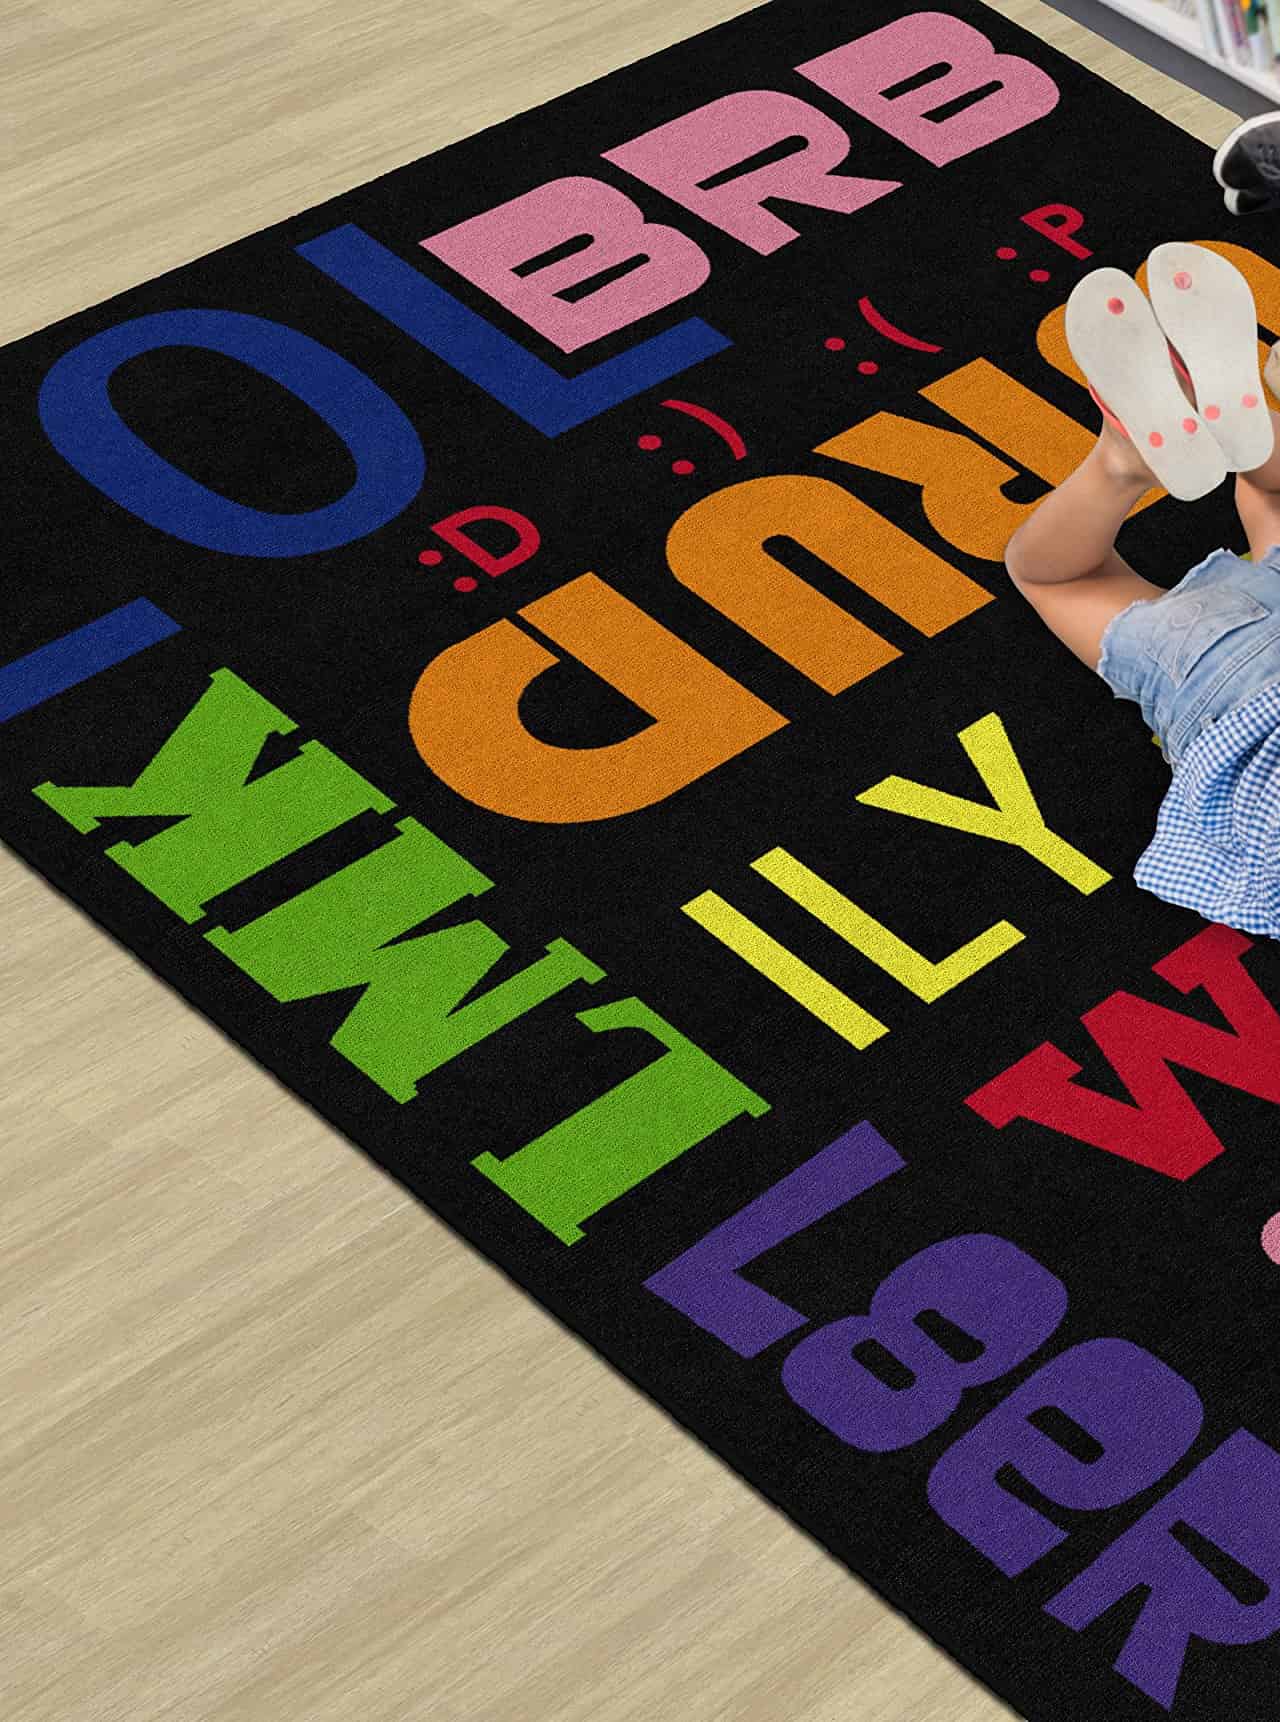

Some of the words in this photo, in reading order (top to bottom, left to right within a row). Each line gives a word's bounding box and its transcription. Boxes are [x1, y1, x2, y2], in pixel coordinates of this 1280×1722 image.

[420, 12, 1061, 354] BRB
[32, 667, 770, 1246] LMK
[681, 711, 1112, 1051] ILY
